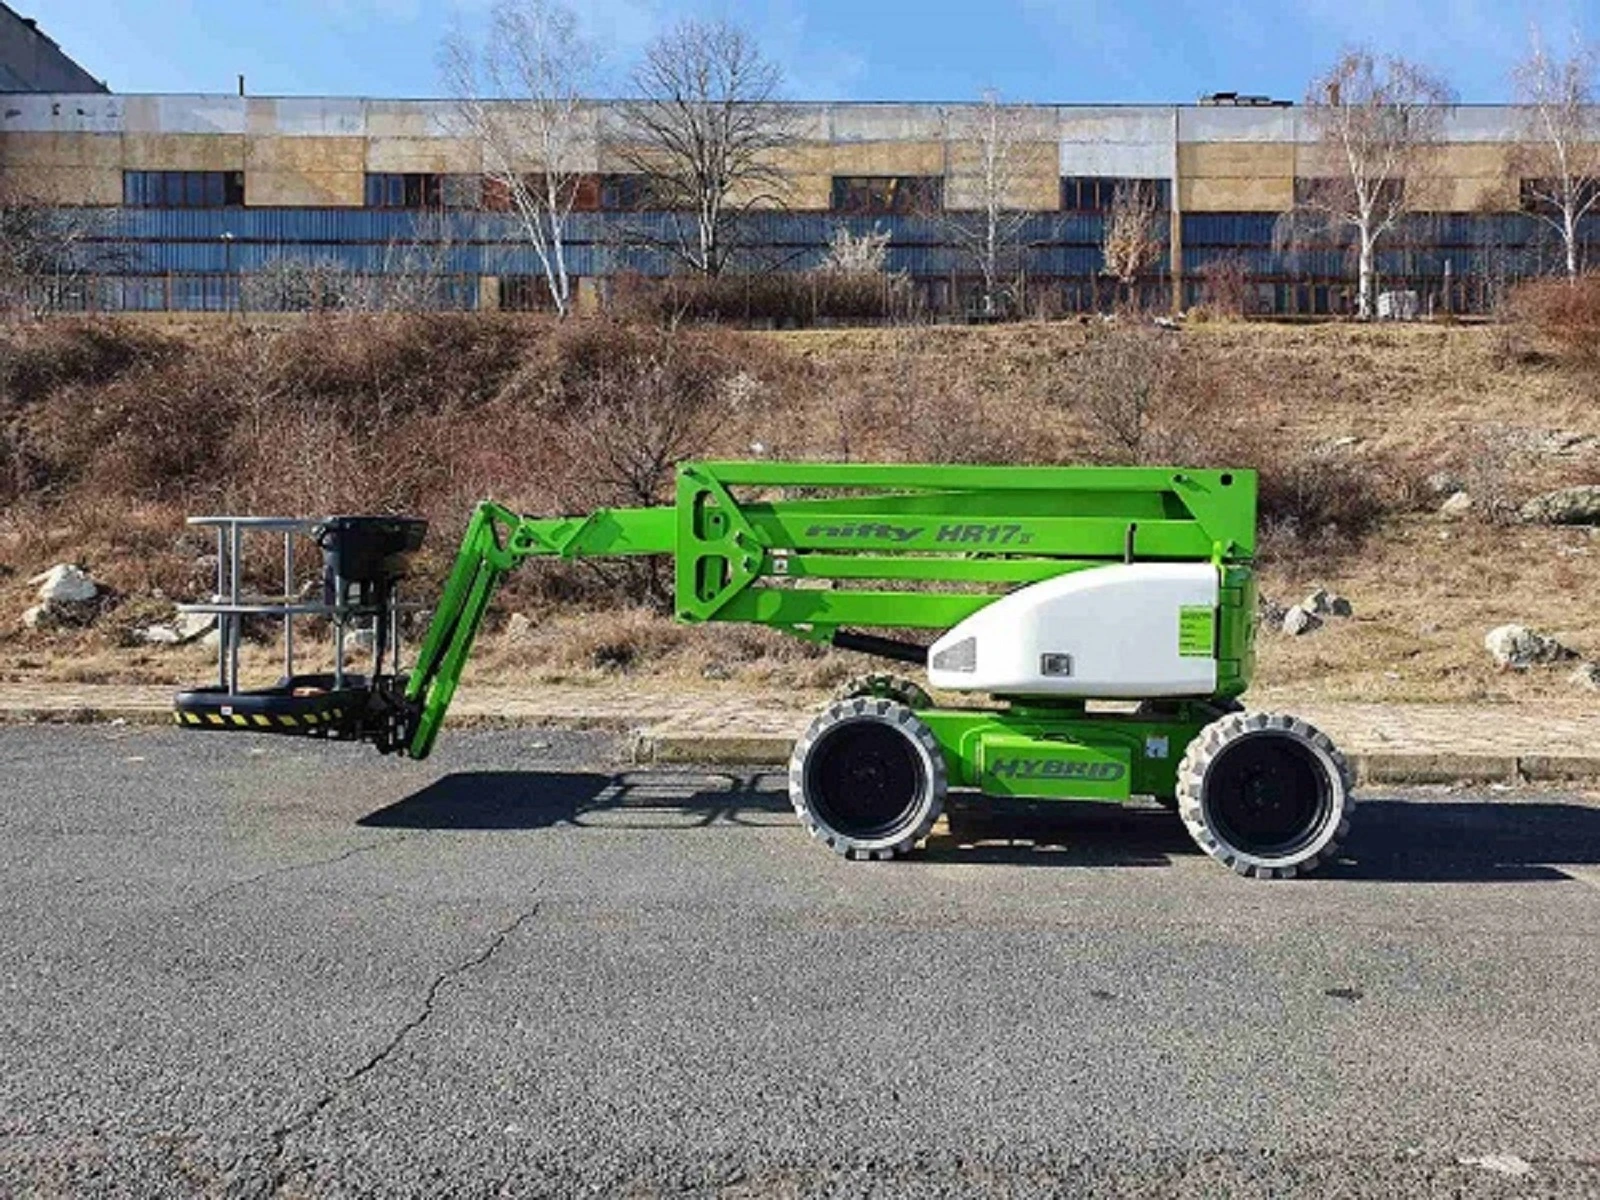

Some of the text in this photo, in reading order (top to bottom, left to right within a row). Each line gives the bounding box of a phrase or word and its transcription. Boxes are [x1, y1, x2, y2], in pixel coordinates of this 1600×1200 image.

[805, 522, 925, 542] nifty
[936, 524, 1021, 544] HR17
[990, 758, 1126, 782] HYBRID
